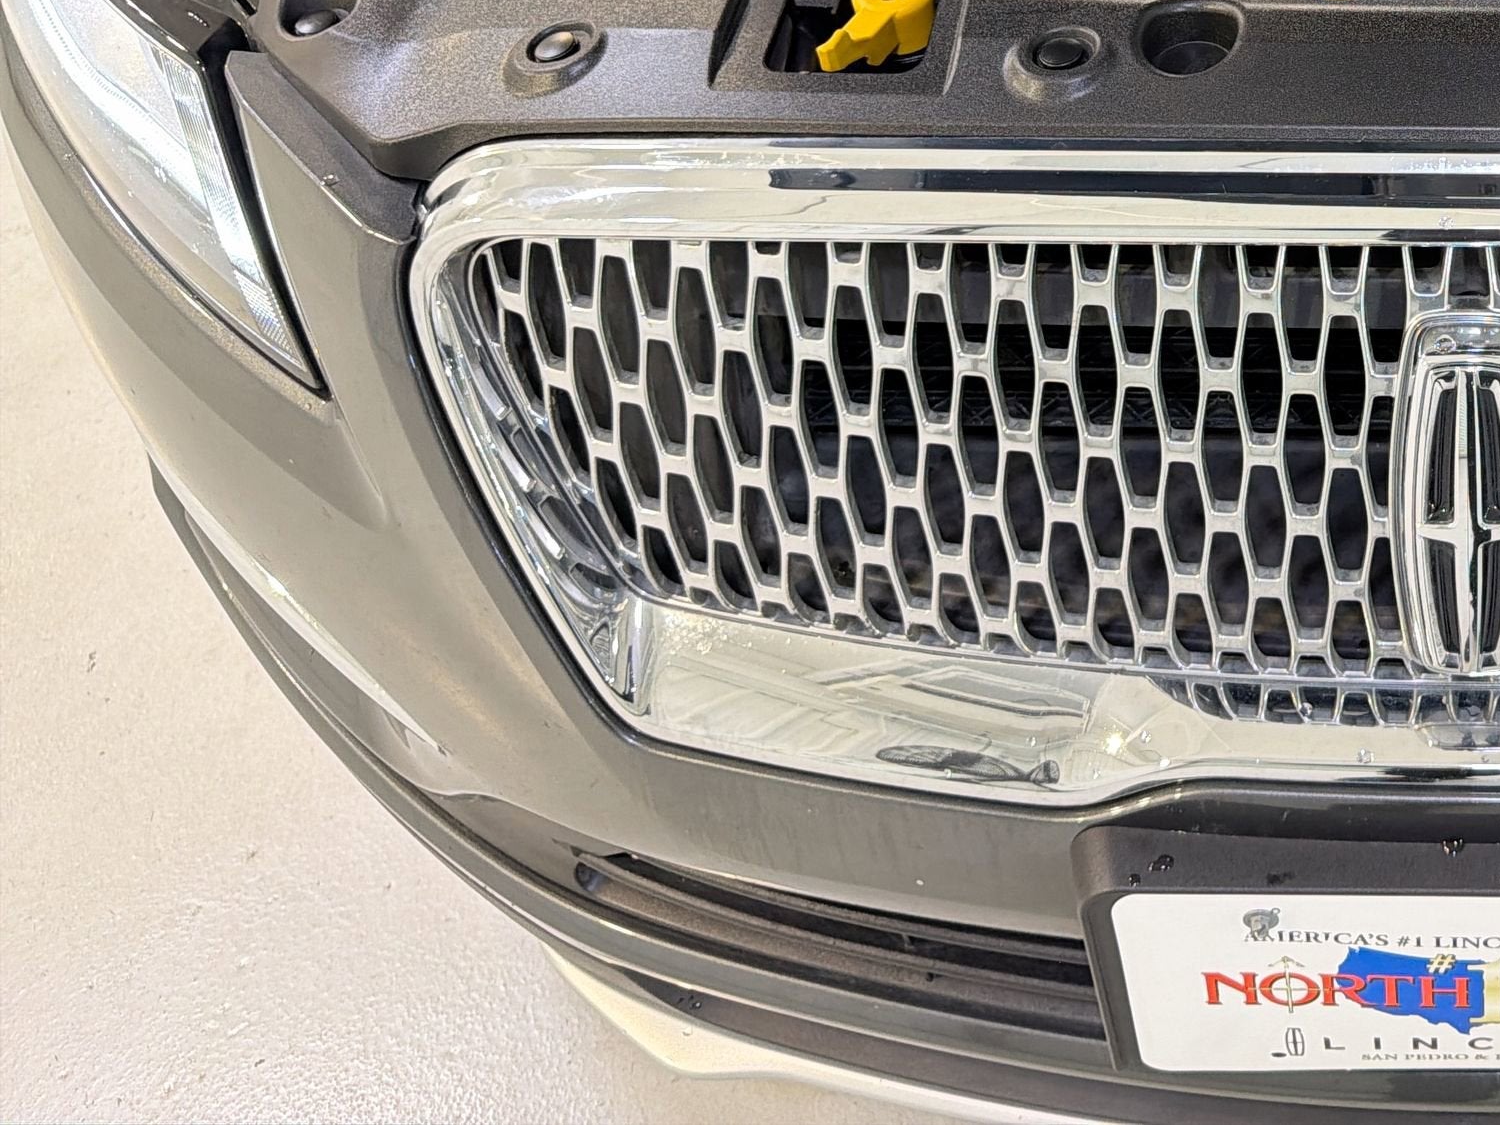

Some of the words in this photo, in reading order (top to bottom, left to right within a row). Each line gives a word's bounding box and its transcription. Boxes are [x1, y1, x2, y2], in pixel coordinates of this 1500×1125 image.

[1397, 935, 1424, 947] #1
[1203, 971, 1471, 1009] NORTH
[1361, 1052, 1399, 1062] SAN
[1404, 1052, 1469, 1062] PEDRO
